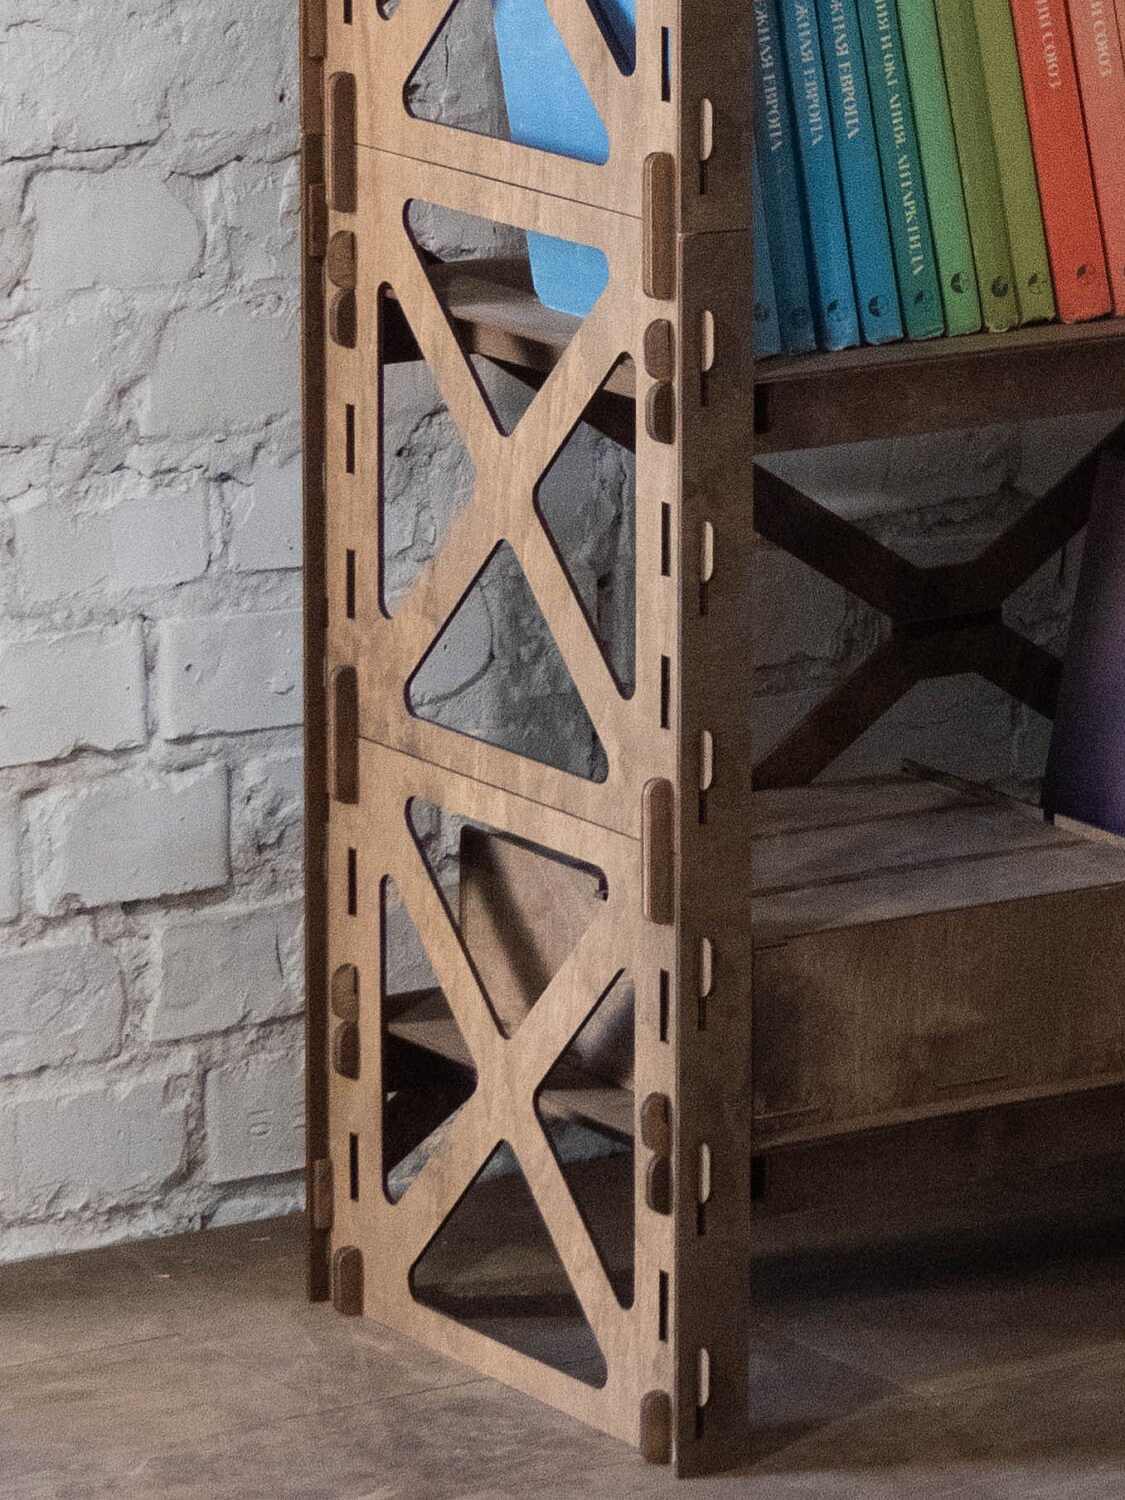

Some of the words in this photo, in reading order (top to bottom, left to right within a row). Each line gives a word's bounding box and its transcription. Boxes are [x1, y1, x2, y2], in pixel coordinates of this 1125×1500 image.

[1042, 31, 1063, 91] СОЮЗ
[1091, 19, 1113, 78] СОЮЗ
[762, 73, 785, 152] ЕВРОПА
[803, 66, 825, 148] ЕВРОПА
[837, 60, 861, 141] ЕВРОПА
[879, 33, 892, 51] И
[894, 152, 925, 277] АНТАРКТИДА
